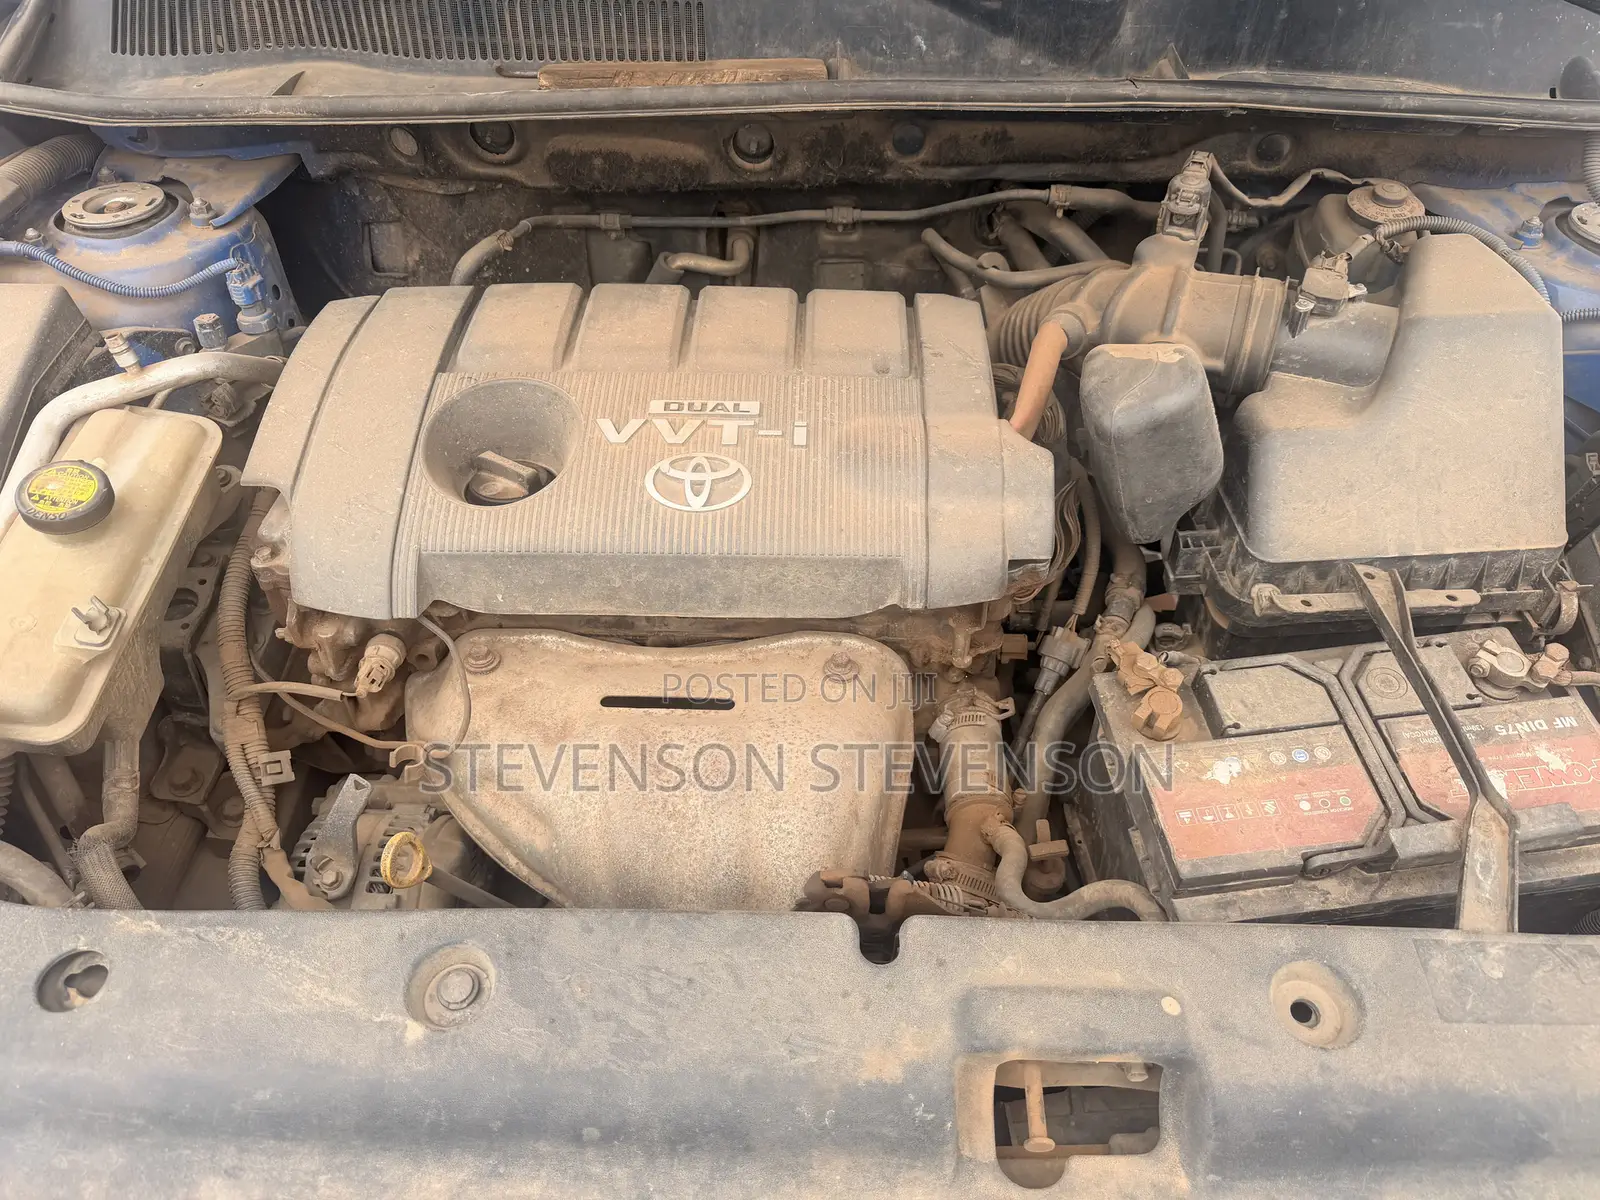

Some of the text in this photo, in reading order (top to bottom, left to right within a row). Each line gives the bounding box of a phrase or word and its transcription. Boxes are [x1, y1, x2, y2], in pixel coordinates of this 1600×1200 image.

[663, 401, 750, 413] DUAL
[595, 418, 807, 446] VVT-i
[26, 507, 68, 520] DENSO
[1494, 716, 1579, 736] MF DIN75
[1402, 729, 1439, 739] 00A(CCA)
